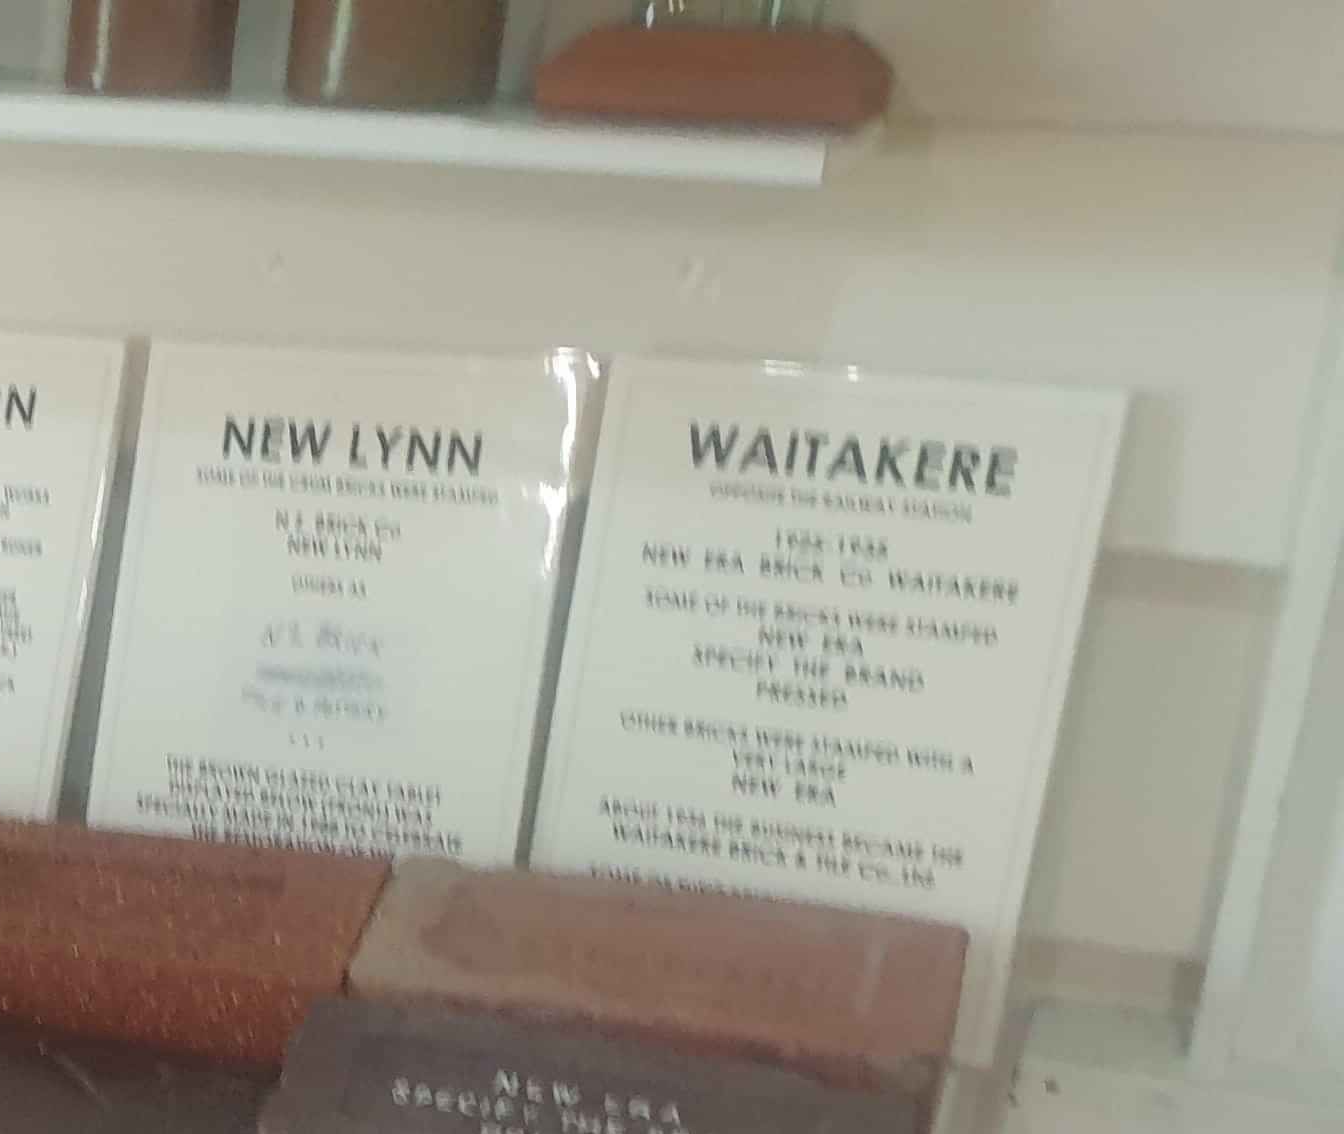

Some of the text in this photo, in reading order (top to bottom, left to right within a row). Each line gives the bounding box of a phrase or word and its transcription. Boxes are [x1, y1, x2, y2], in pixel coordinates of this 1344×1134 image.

[221, 414, 484, 477] NEW LYNN
[688, 417, 1020, 497] WAITAKERE
[286, 537, 384, 563] NEW LYNN
[642, 541, 691, 567] NEW
[704, 549, 745, 574] ERA
[759, 553, 824, 583] BRICK
[888, 569, 1020, 606] WAITAKERE
[645, 587, 999, 646] SOME OF THE BRICKS WERE STAMPED
[692, 642, 926, 692] SPECIFY THE BRAND
[757, 628, 864, 657] NEW ERA
[755, 679, 848, 708] PRESSED
[620, 710, 679, 737] OTHER
[683, 716, 749, 743] BRICKS
[755, 724, 806, 750] WERE
[812, 730, 901, 764] STAMPED
[906, 742, 955, 772] WITH
[730, 749, 847, 781] VERY LARGE
[600, 799, 659, 825] ABOUT
[713, 810, 745, 831] THE
[730, 774, 838, 807] NEW ERA
[612, 825, 721, 856] WAITAKERE
[728, 839, 788, 869] BRICK
[391, 1075, 540, 1124] SPECIFY
[492, 1068, 681, 1127] NEW ERA
